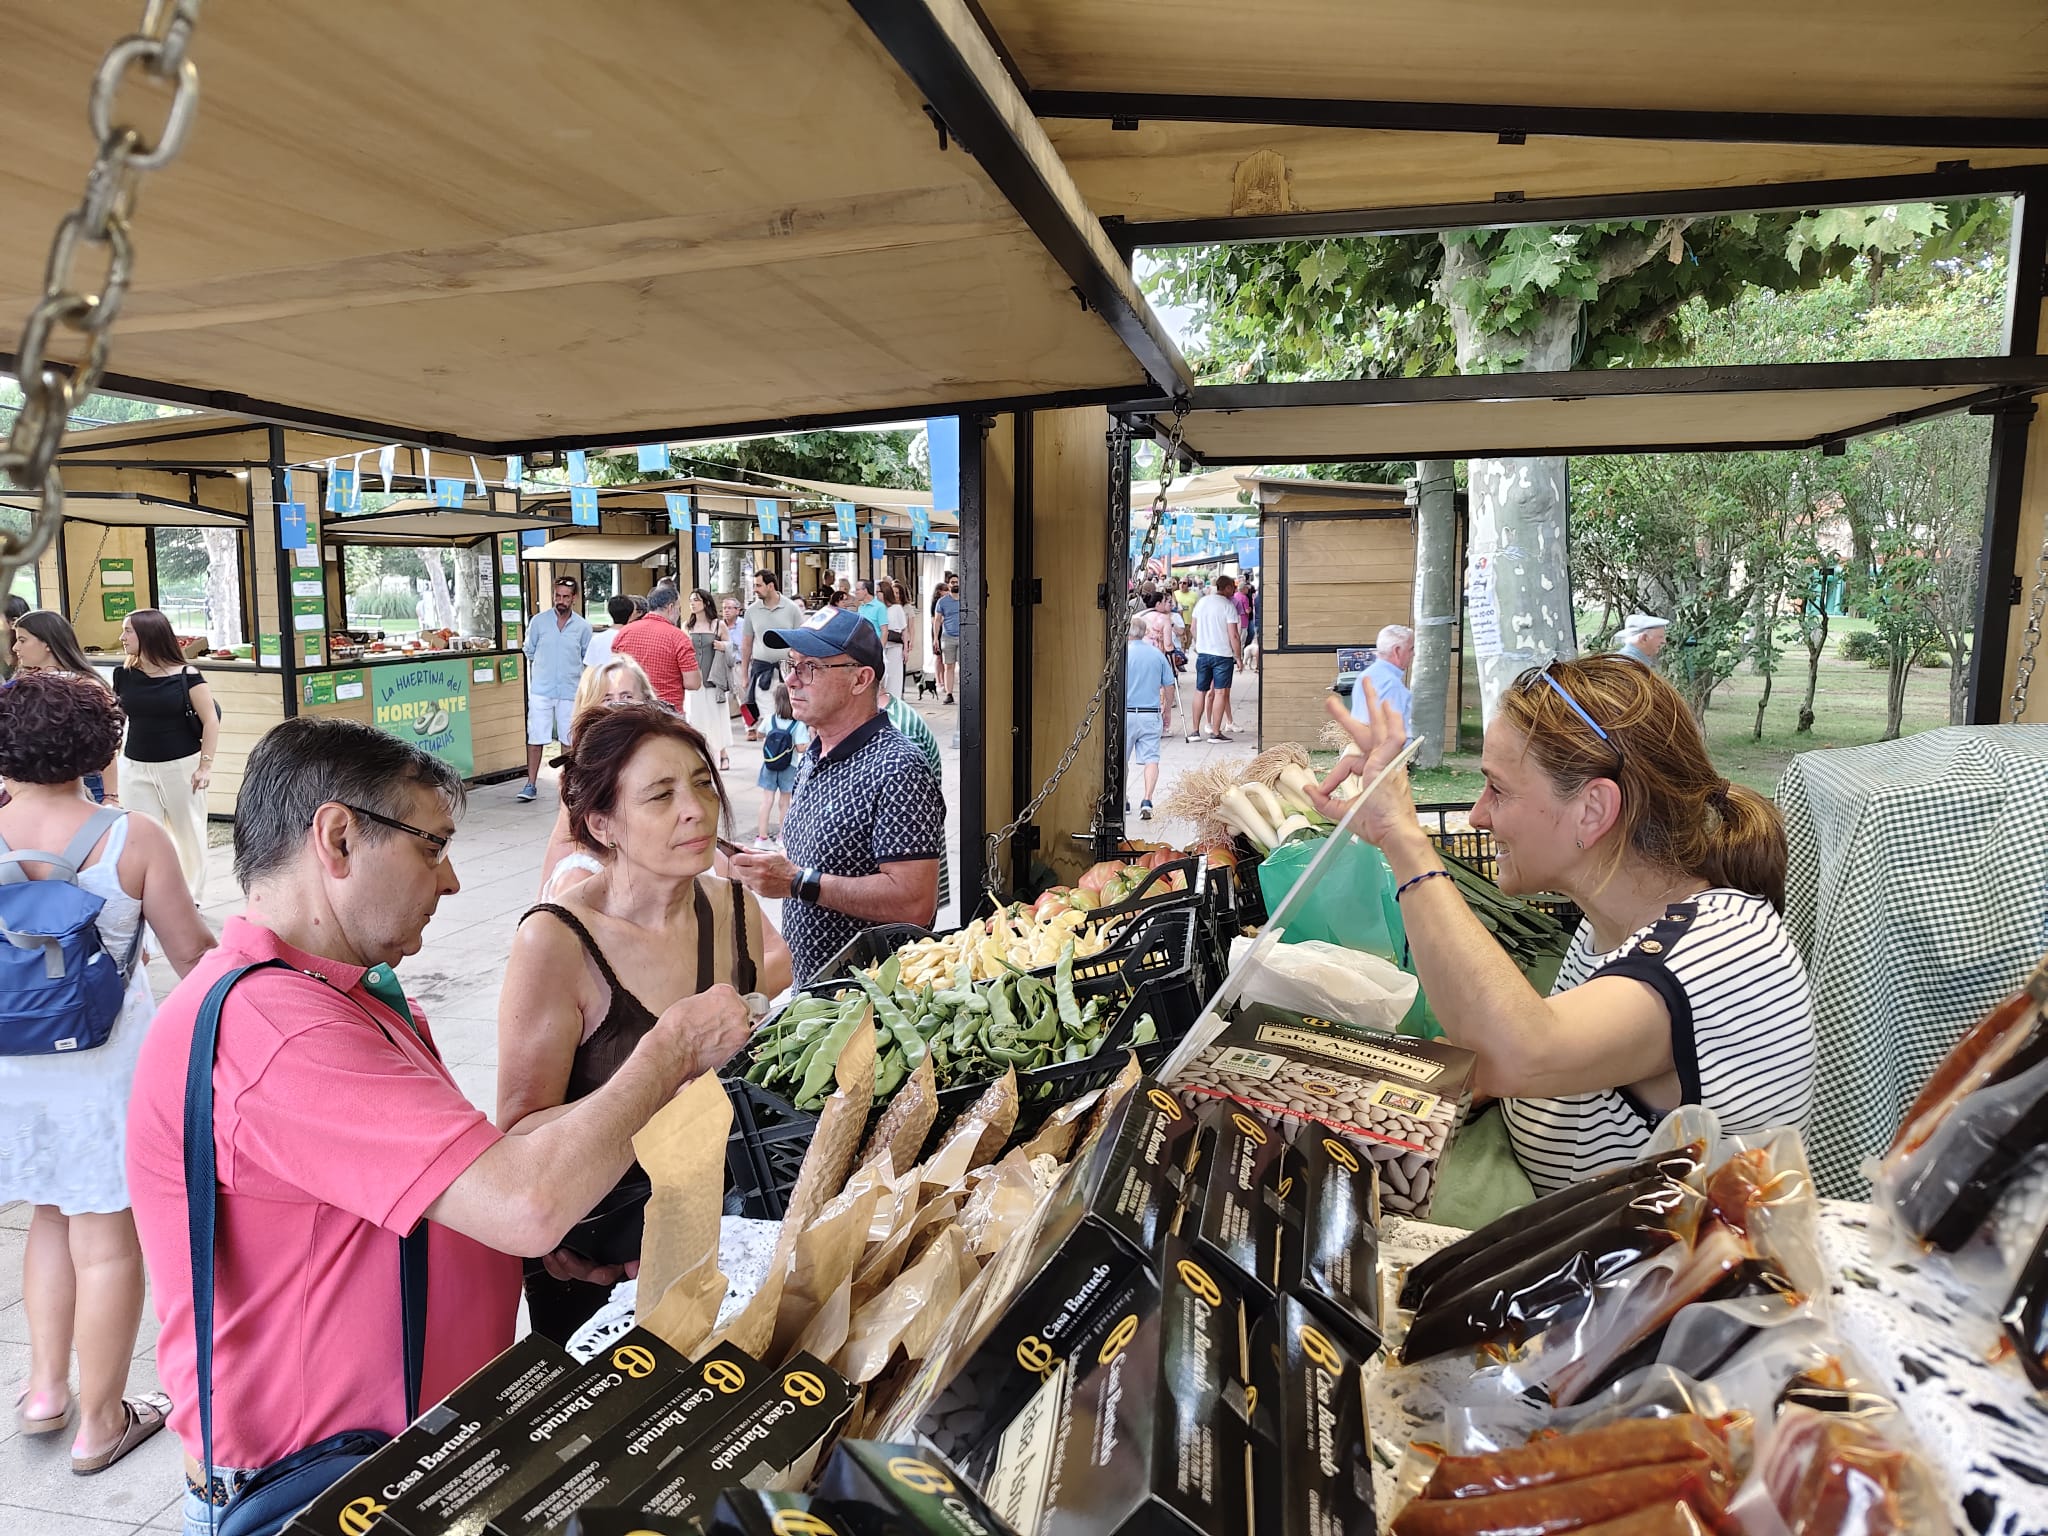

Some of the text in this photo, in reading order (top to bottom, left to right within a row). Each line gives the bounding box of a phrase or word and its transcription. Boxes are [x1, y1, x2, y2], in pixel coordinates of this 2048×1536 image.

[377, 696, 467, 723] HORIZNTE
[381, 670, 462, 702] La HUERTINA del
[1269, 1030, 1317, 1045] Faba
[1323, 1042, 1426, 1074] Asturiana
[1042, 1312, 1071, 1339] Casa
[1064, 1264, 1111, 1313] Bartuelo
[1193, 1298, 1214, 1393] Casa Bartuelo
[529, 1373, 623, 1442] Casa Bartuelo
[626, 1387, 714, 1456] Casa Bartuelo
[711, 1400, 796, 1471] Casa Bartuelo
[1316, 1368, 1341, 1478] Casa Bartuelo
[382, 1469, 424, 1500] Casa
[416, 1421, 482, 1471] Bartuelo
